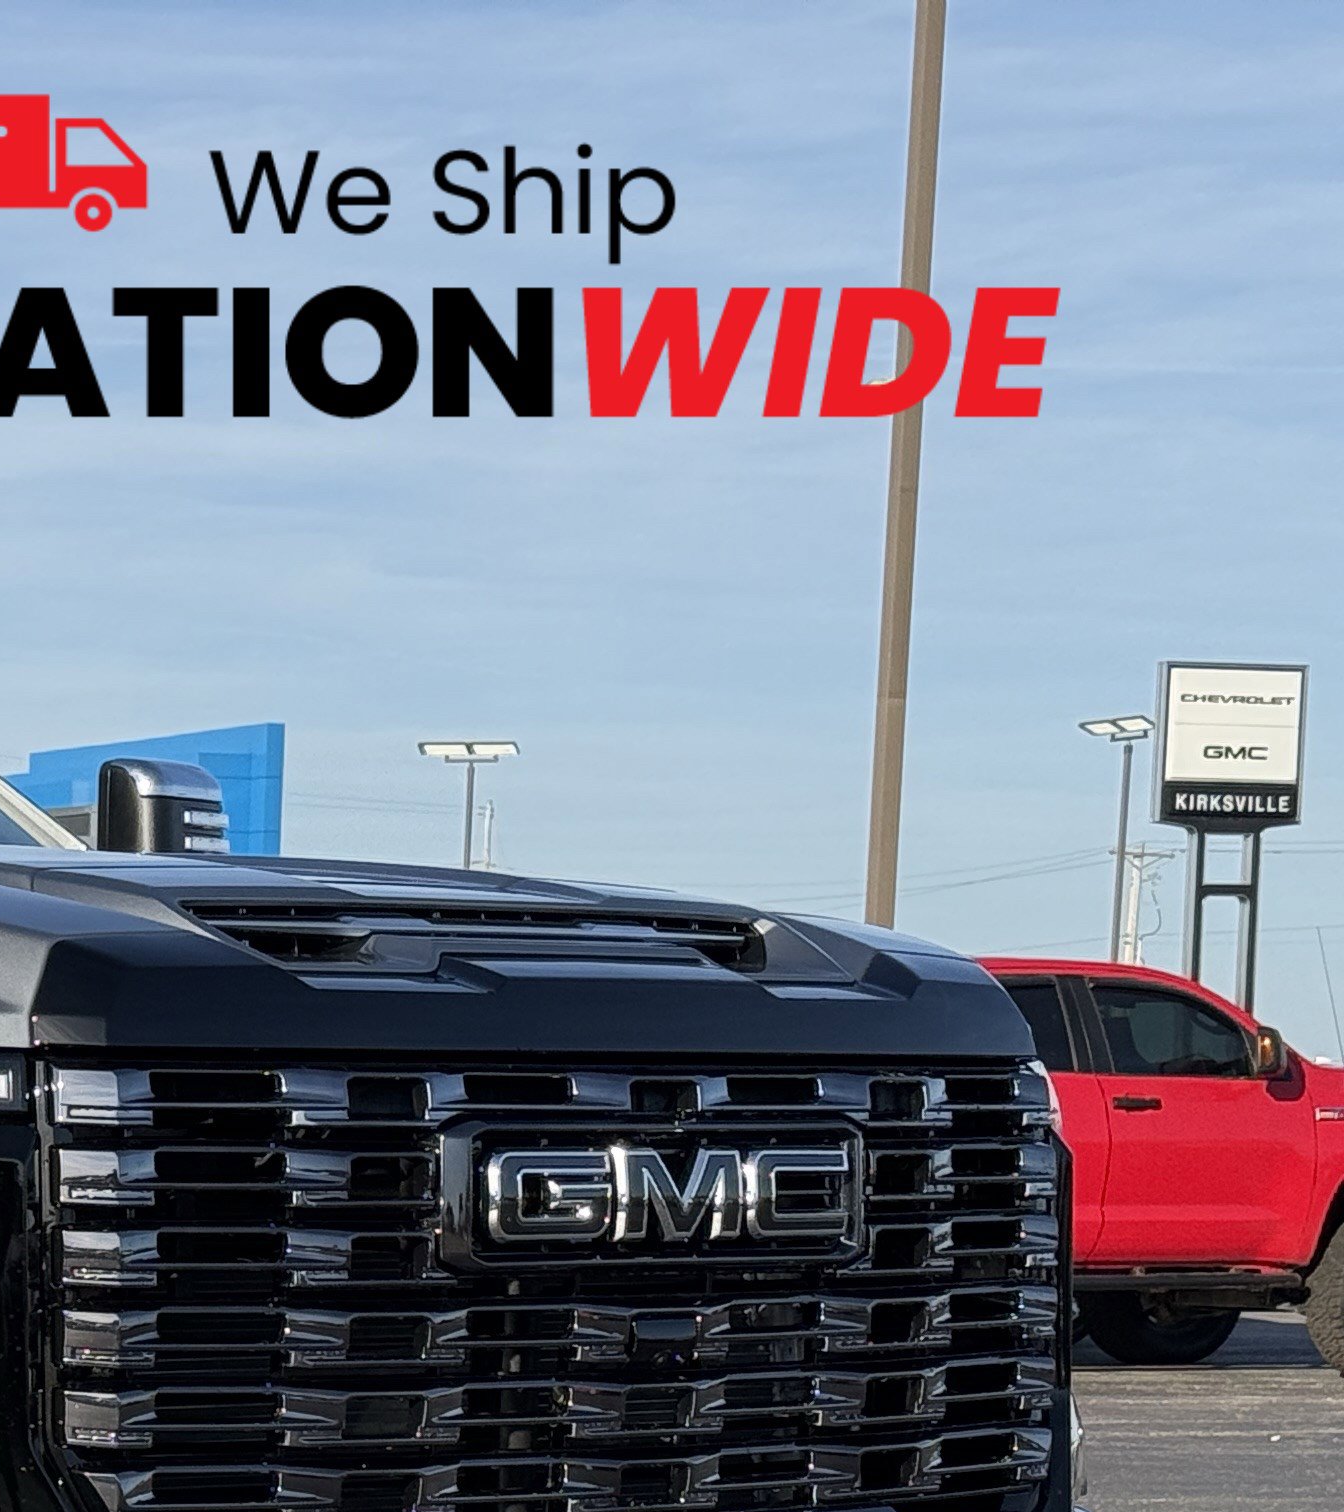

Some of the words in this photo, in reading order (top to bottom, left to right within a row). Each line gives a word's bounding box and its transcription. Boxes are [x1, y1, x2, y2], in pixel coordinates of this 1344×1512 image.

[1179, 693, 1296, 706] CHEVROLET
[1202, 745, 1269, 761] GMC
[1174, 792, 1291, 814] KIRKSVILLE
[487, 1146, 849, 1242] GMC
